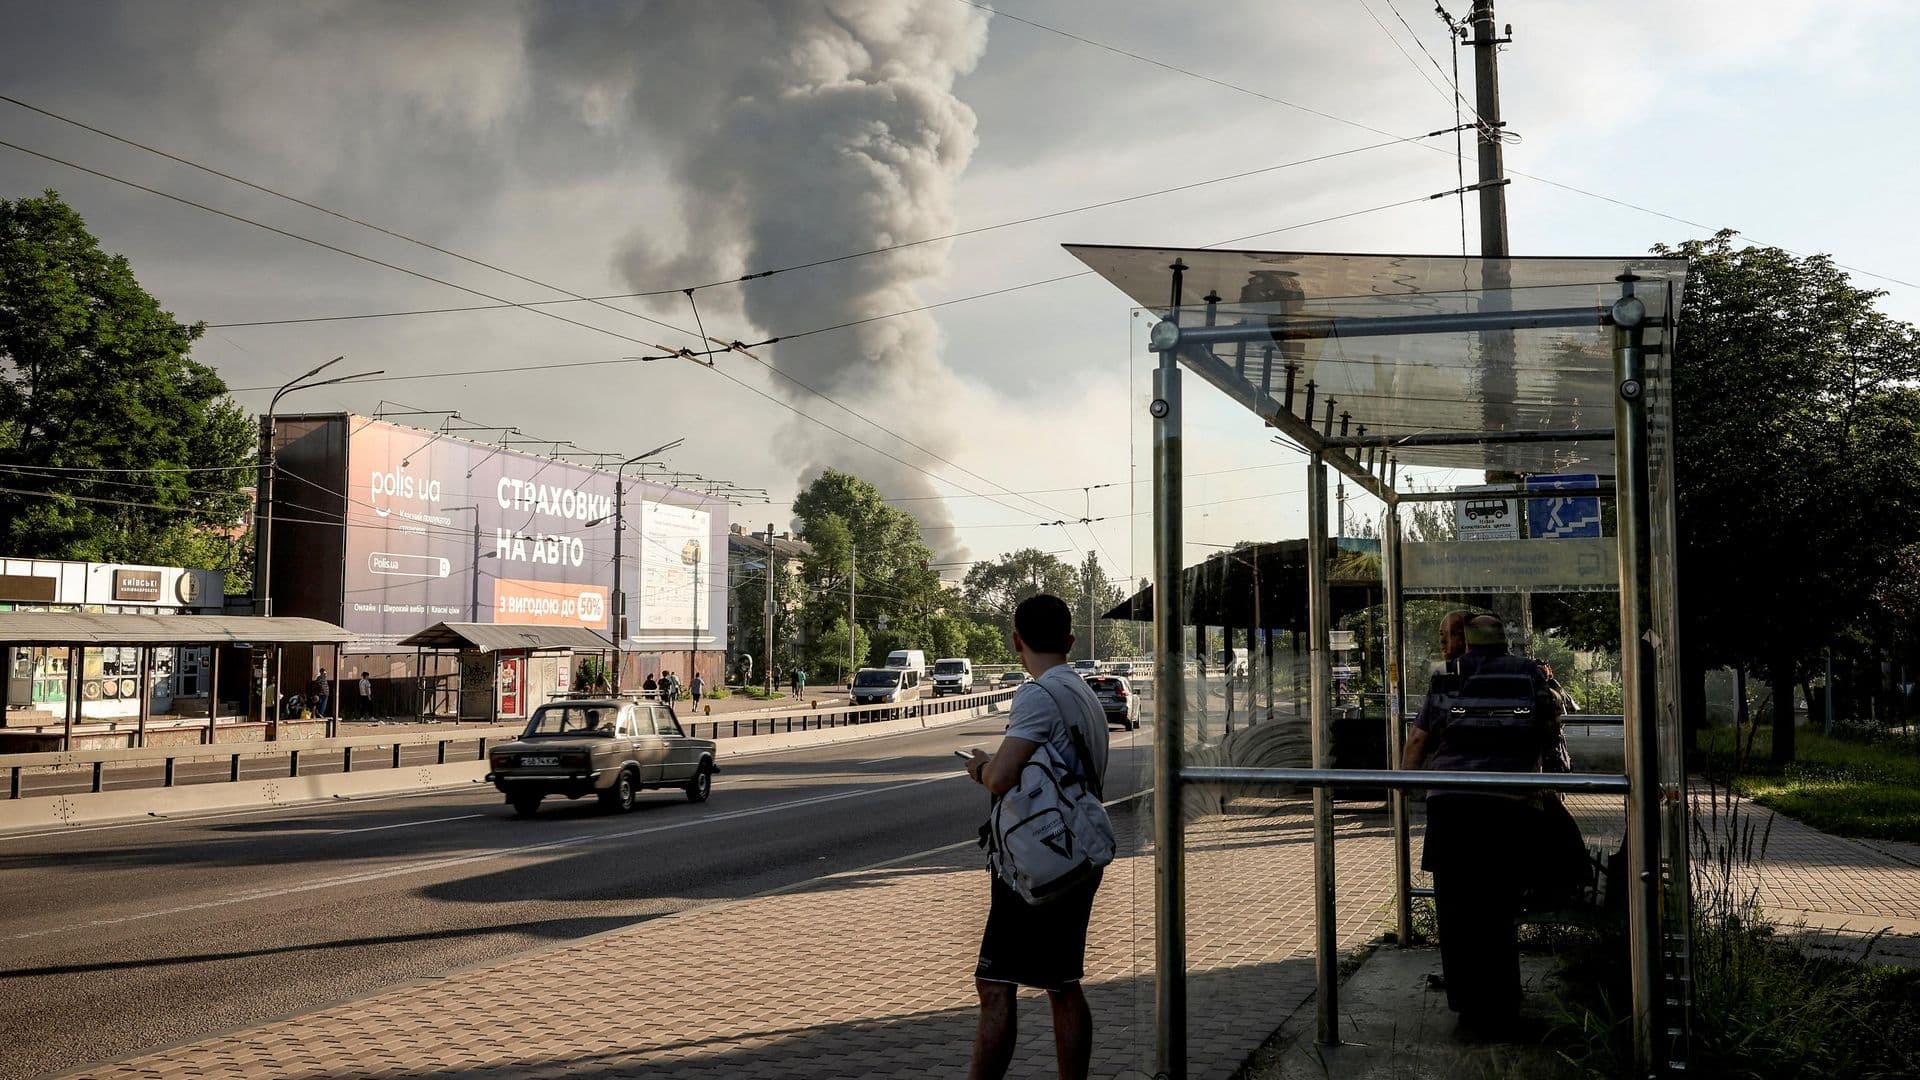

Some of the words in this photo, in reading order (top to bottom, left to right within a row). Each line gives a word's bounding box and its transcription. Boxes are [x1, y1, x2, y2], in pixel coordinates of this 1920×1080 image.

[371, 465, 413, 503] polis
[418, 478, 441, 502] ua
[497, 476, 611, 524] СТРАХОВКИ
[496, 527, 527, 562] НА
[531, 533, 584, 567] АВТО
[373, 557, 399, 570] Polis.ua
[122, 577, 158, 586] КИЇВСЬКІ
[354, 603, 376, 612] Онлайн
[383, 604, 409, 614] Широкий
[410, 604, 425, 614] вибір
[508, 595, 559, 616] ВИГОДОЮ
[561, 599, 575, 617] ДО
[580, 597, 602, 616] 50%
